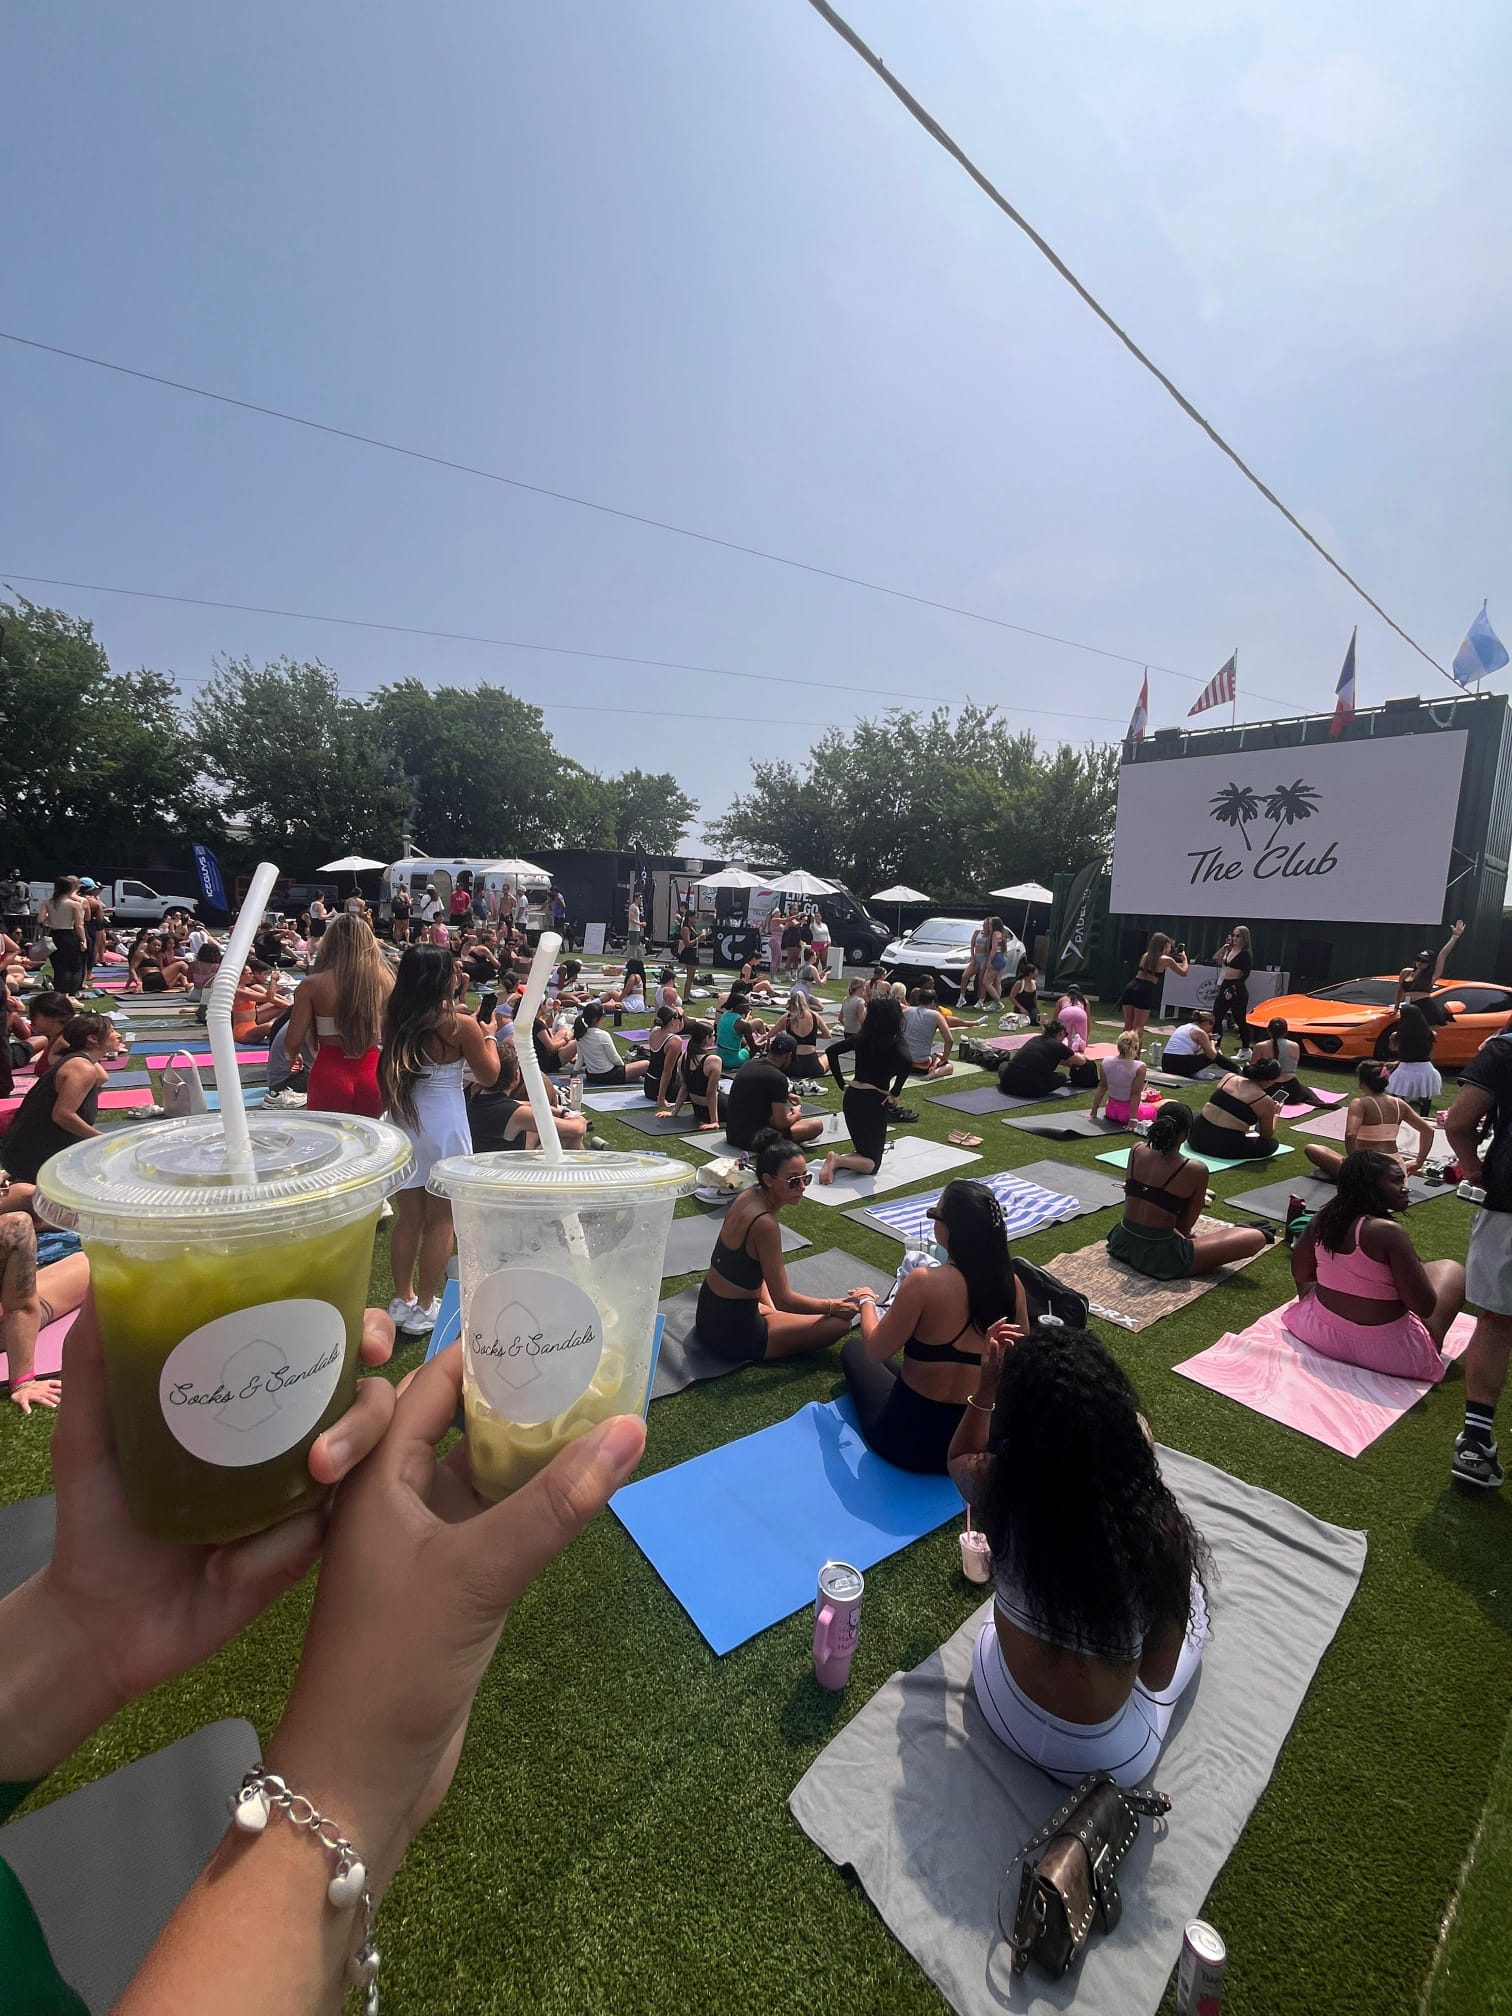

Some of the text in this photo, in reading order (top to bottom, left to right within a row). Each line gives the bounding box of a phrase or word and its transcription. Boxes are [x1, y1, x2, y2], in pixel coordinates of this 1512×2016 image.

[198, 856, 214, 897] ICEGUYS
[1187, 841, 1339, 885] The Club
[472, 1325, 596, 1357] Socks & Sandals
[169, 1343, 340, 1406] Socks & Sandals
